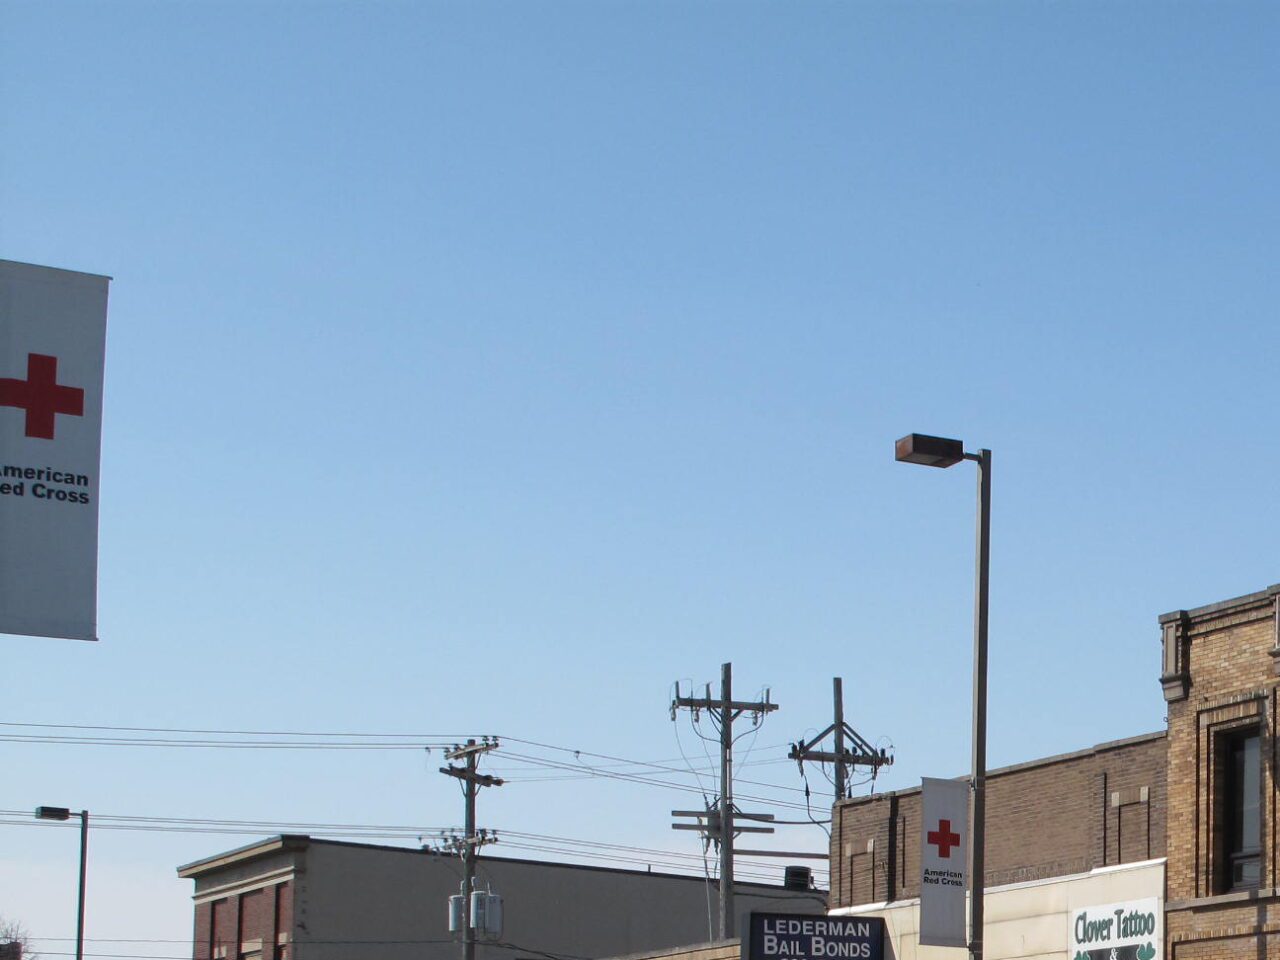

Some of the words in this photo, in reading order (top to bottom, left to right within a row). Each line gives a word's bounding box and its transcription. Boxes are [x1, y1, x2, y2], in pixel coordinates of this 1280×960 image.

[0, 465, 89, 486] merican
[0, 482, 24, 496] ed
[32, 483, 89, 504] Cross
[923, 876, 939, 884] Red
[941, 878, 962, 886] Cross
[924, 868, 962, 878] American
[764, 919, 870, 937] LEDERMAN
[1075, 911, 1113, 944] Clover
[1114, 909, 1155, 939] Tattoo
[1109, 947, 1118, 960] &
